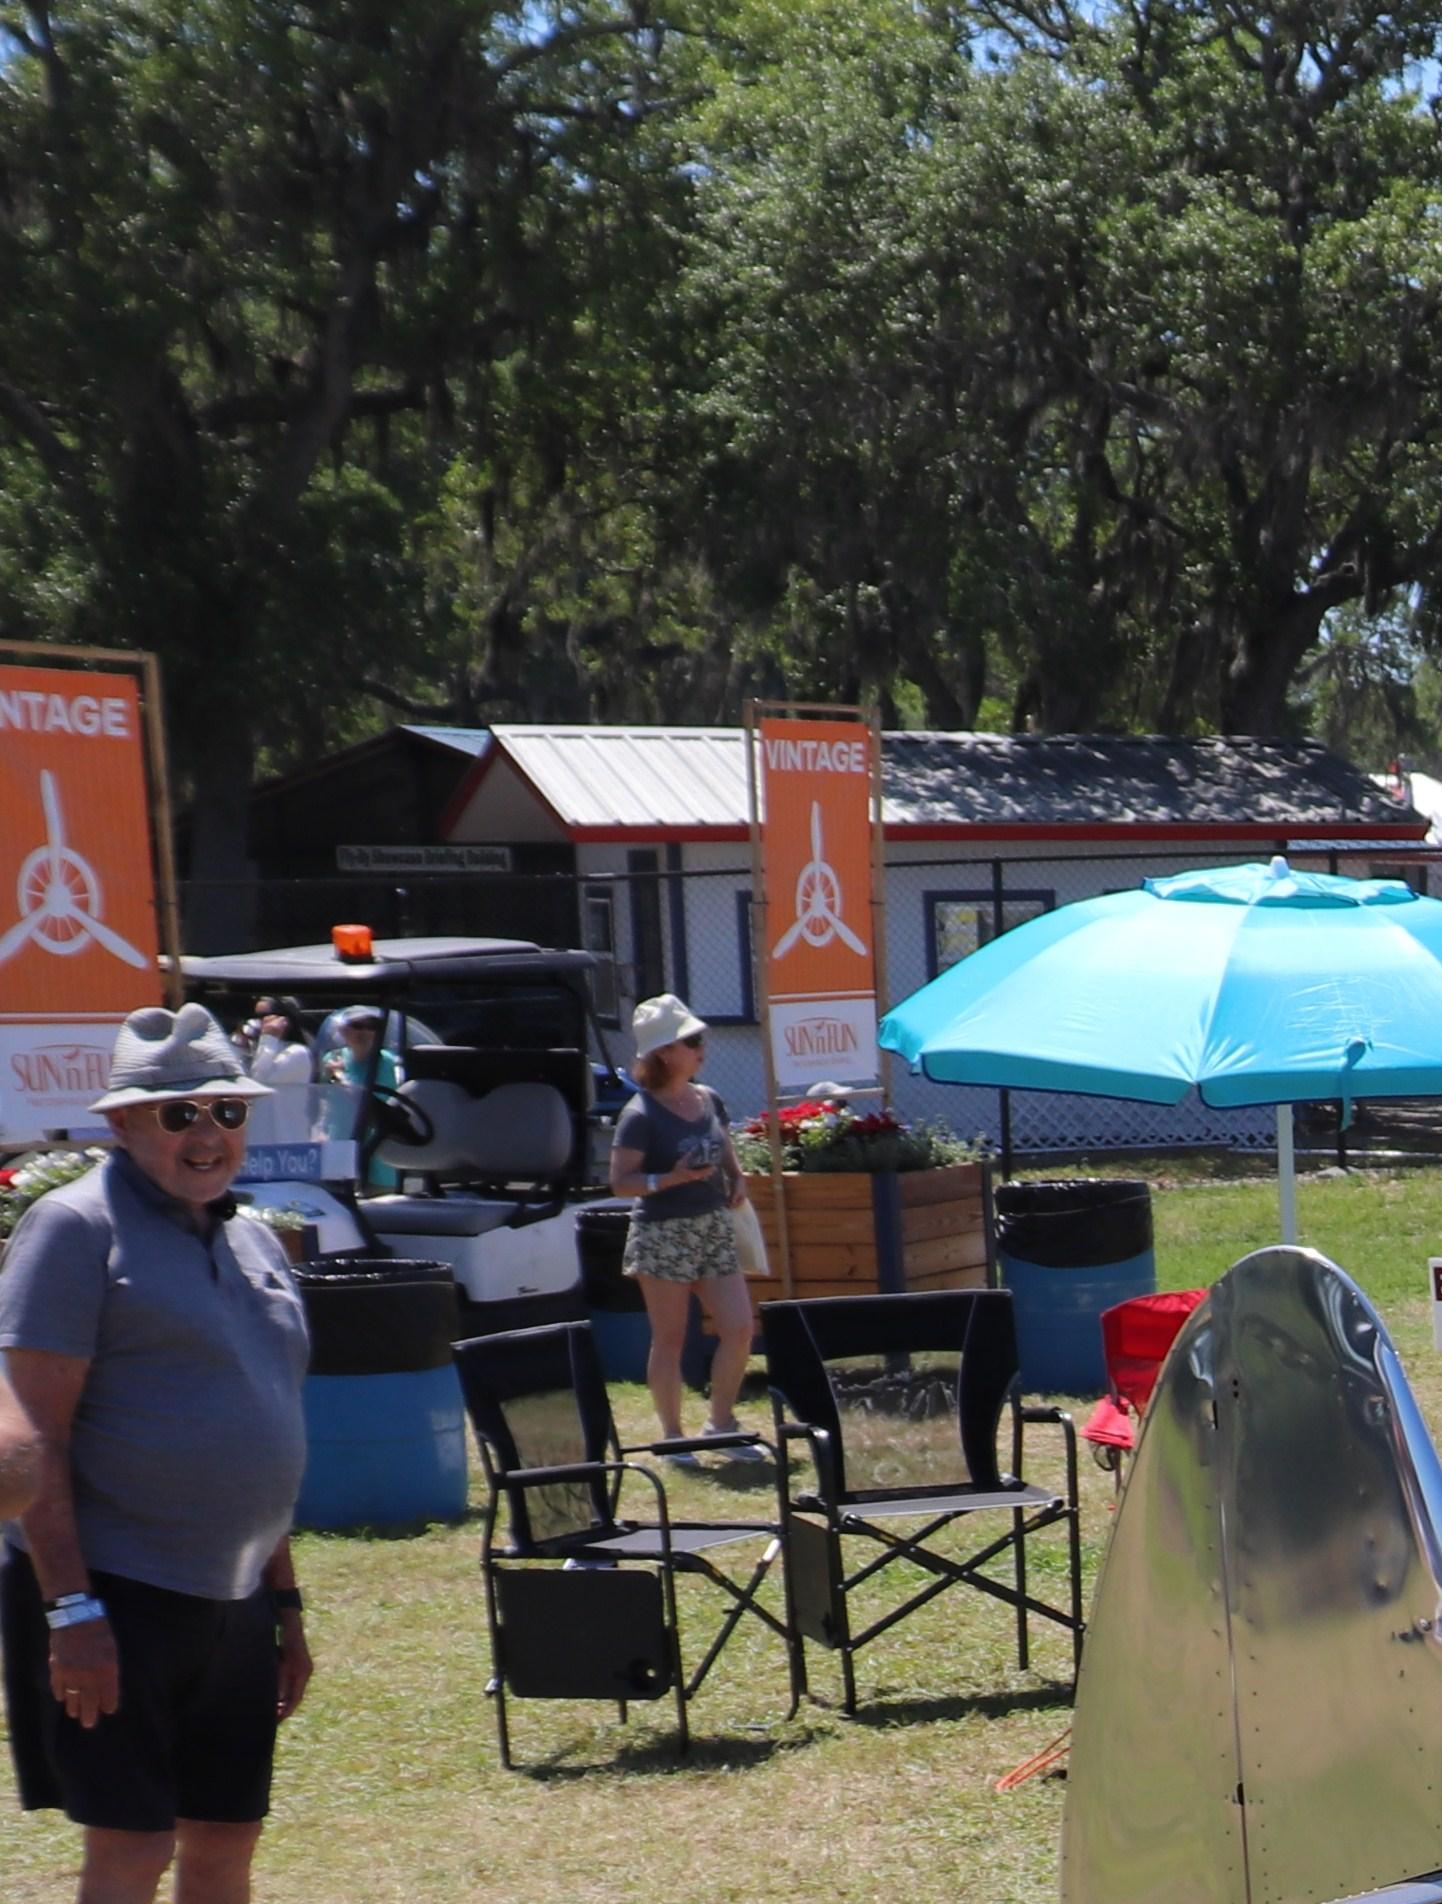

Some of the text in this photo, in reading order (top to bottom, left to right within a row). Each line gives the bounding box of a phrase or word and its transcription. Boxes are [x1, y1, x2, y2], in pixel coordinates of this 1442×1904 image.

[0, 689, 129, 737] NTAGE
[765, 739, 865, 772] VINTAGE
[278, 1148, 318, 1174] You?
